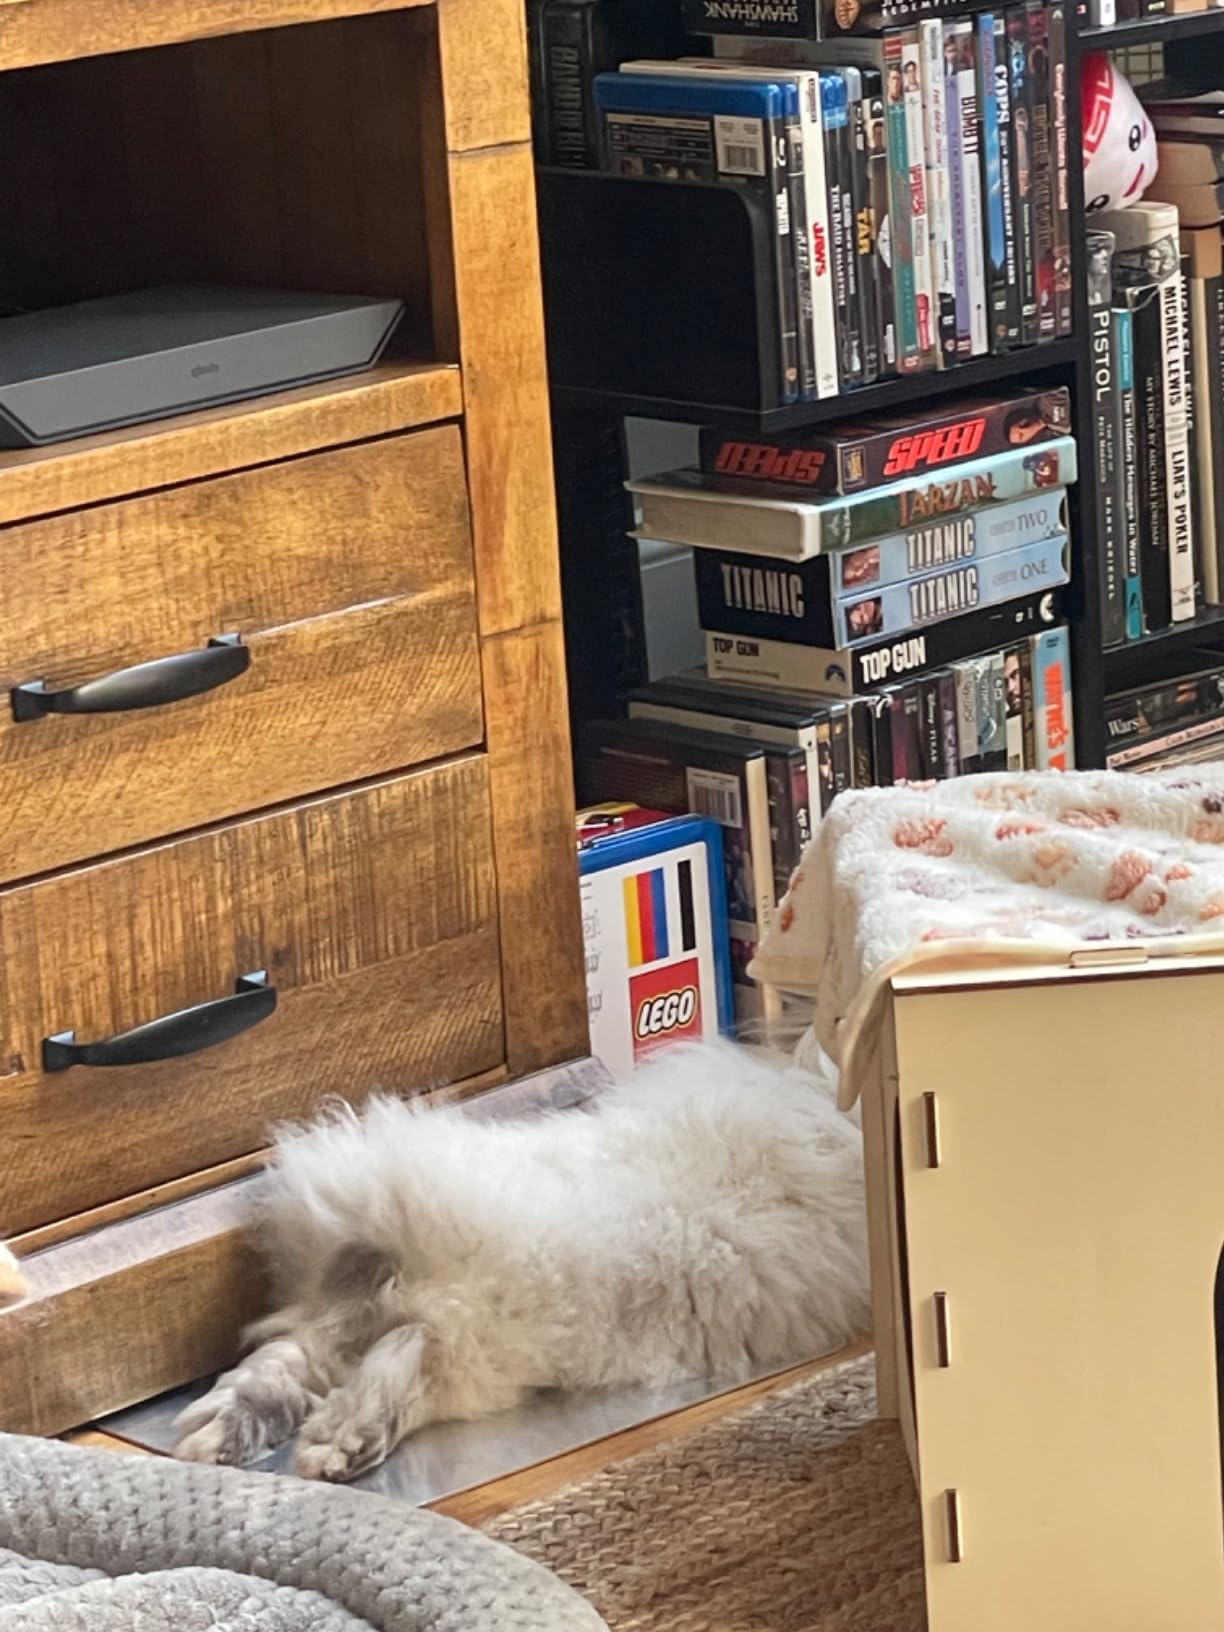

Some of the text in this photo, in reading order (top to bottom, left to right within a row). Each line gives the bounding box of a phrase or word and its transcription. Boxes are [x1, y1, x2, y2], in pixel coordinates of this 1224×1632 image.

[705, 5, 798, 23] SHAWSHANK
[994, 65, 1010, 123] COPS
[812, 221, 827, 277] JAWS
[1093, 310, 1112, 402] PISTOL
[1164, 286, 1182, 406] MICHAEL LEWIS
[1123, 392, 1134, 415] The
[714, 440, 827, 485] SPEED
[882, 418, 987, 477] SPEED
[1124, 418, 1136, 462] Hidden
[1149, 449, 1158, 498] MICHAEL
[899, 472, 998, 527] TARZAN
[1017, 509, 1049, 532] TWO
[1151, 501, 1159, 546] JORDAN
[1171, 450, 1189, 555] LIAR'S POKER
[906, 517, 977, 574] TITANIC
[1020, 558, 1049, 581] ONE
[1128, 538, 1139, 574] Water
[720, 563, 805, 619] TITANIC
[908, 566, 980, 620] TITANIC
[713, 637, 760, 657] TOP GUN
[859, 636, 926, 684] TOP GUN
[1107, 717, 1139, 736] Wars
[639, 989, 696, 1038] LEGO
